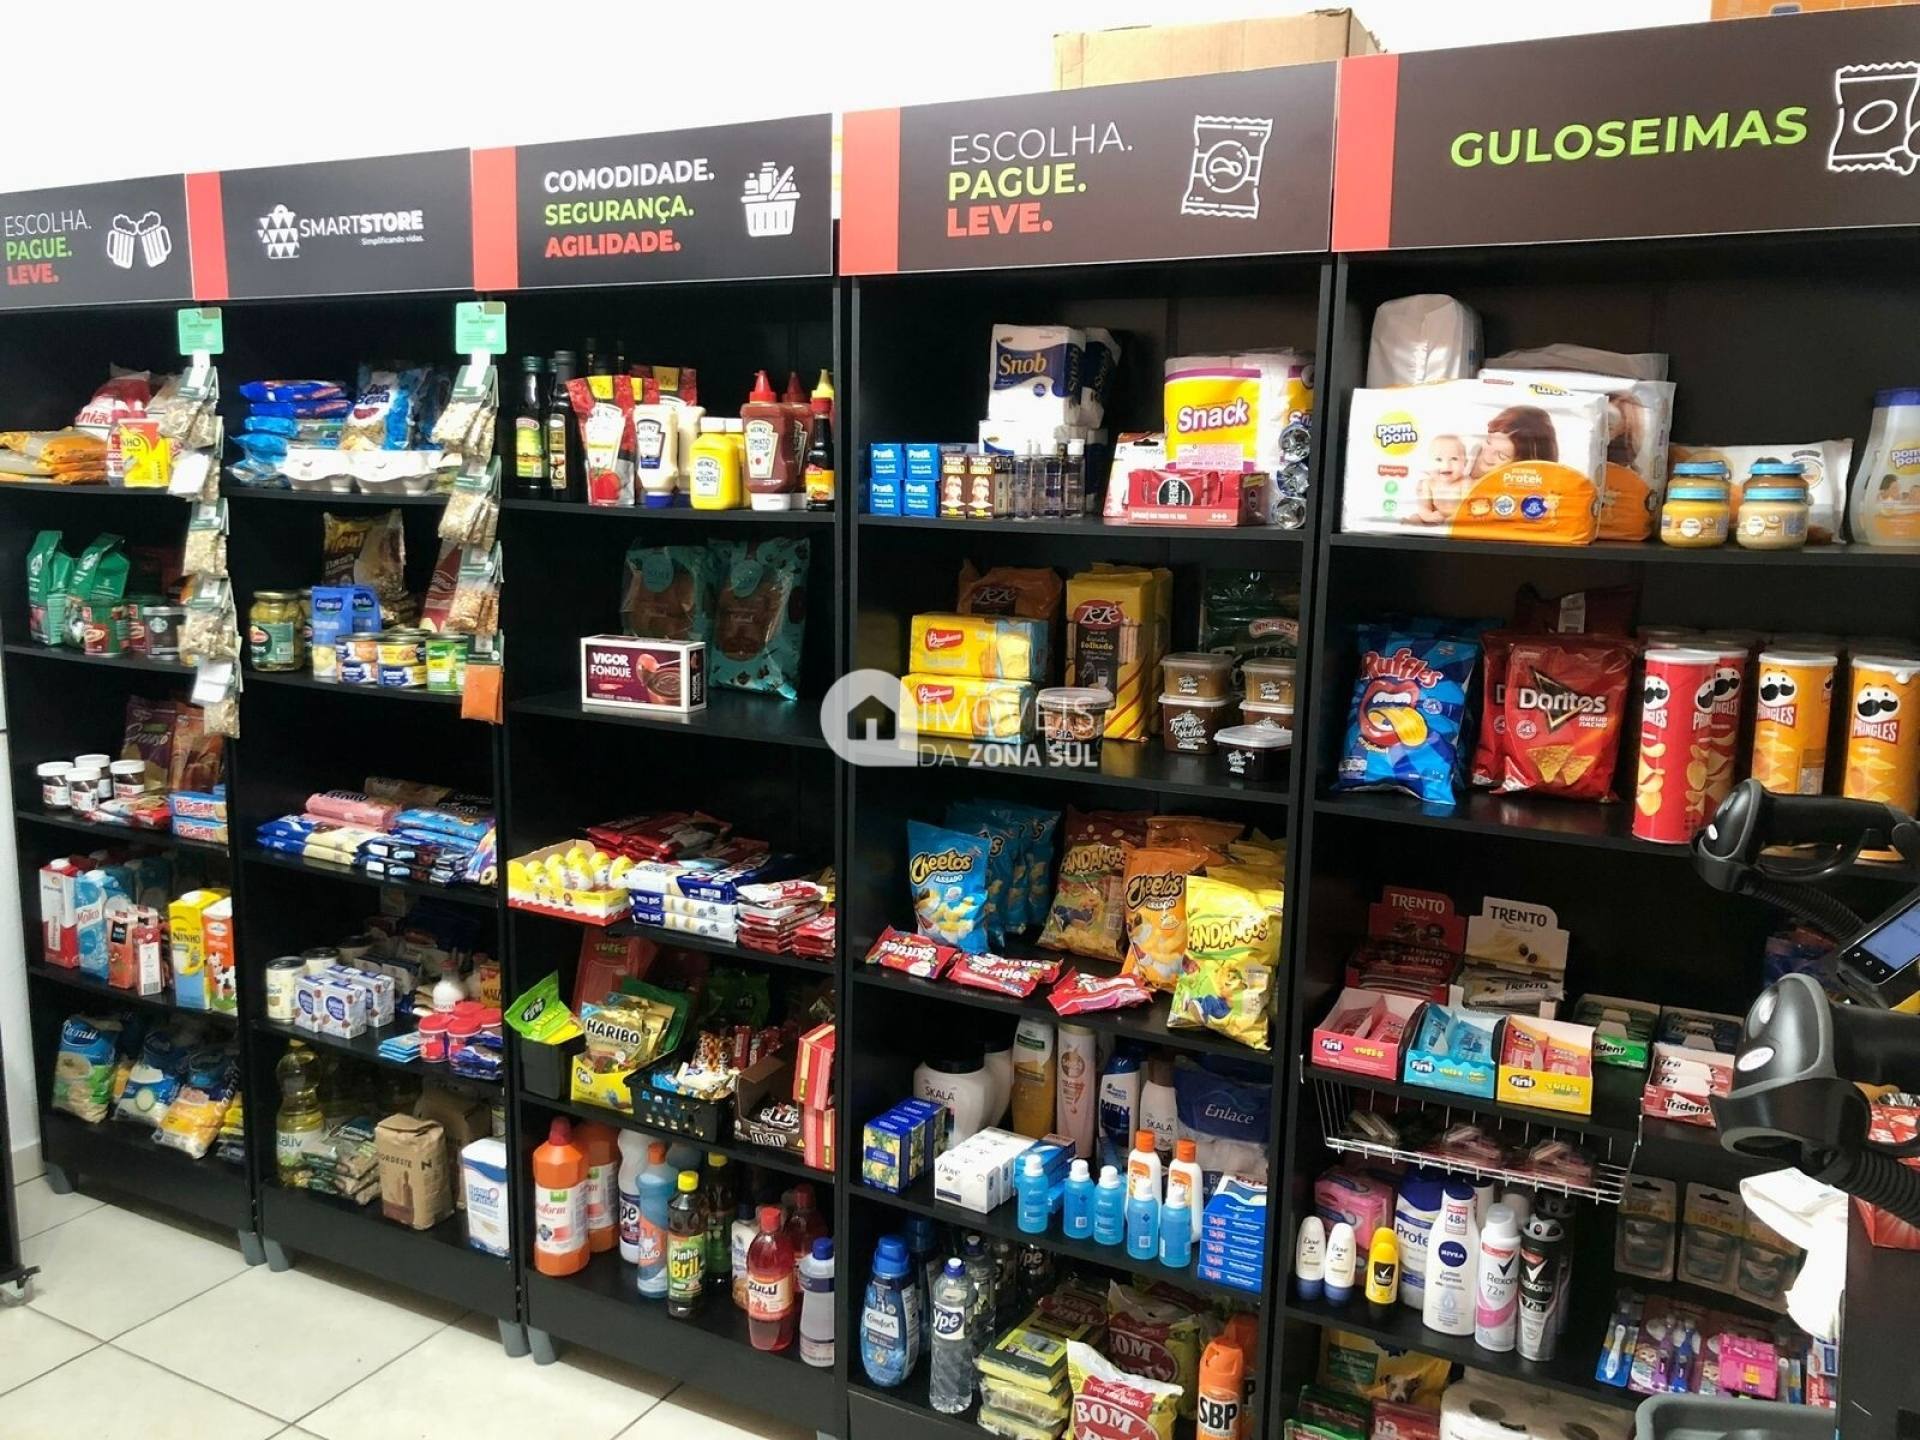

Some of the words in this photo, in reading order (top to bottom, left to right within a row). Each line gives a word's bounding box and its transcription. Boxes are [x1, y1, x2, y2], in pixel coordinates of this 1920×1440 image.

[950, 122, 1133, 165] ESCOLHA.
[1450, 107, 1808, 168] GULOSEIMAS
[544, 158, 715, 193] COMODIDADE.
[948, 163, 1087, 202] PAGUE.
[4, 209, 92, 237] ESCOLHA.
[300, 210, 424, 238] SMARTSTORE
[545, 195, 694, 226] SEGURANÇA.
[947, 202, 1054, 238] LEVE.
[5, 236, 72, 261] PAGUE.
[544, 229, 681, 258] AGILIDADE.
[7, 263, 60, 286] LEVE.
[999, 352, 1047, 376] Snob
[1176, 396, 1249, 433] Snack
[590, 665, 631, 678] FONDUE
[592, 652, 628, 666] VIGOR
[1360, 647, 1444, 688] Ruffles
[1519, 687, 1607, 714] Doritos
[1853, 720, 1899, 742] PRINGLES
[911, 849, 972, 884] Cheetos
[1391, 893, 1446, 914] TRENTO
[1490, 906, 1548, 928] TRENTO
[173, 932, 200, 944] NINHO
[1188, 915, 1268, 951] FANDANGOS
[586, 1019, 641, 1046] HARIBO
[924, 1086, 955, 1102] SKALA
[1101, 1099, 1130, 1115] MEN
[1665, 1098, 1709, 1114] Trident
[1204, 1103, 1255, 1125] Enlace
[1396, 1222, 1429, 1247] Prote
[671, 1259, 699, 1278] Bril
[1075, 1400, 1136, 1435] BOM
[1200, 1397, 1239, 1431] SBP
